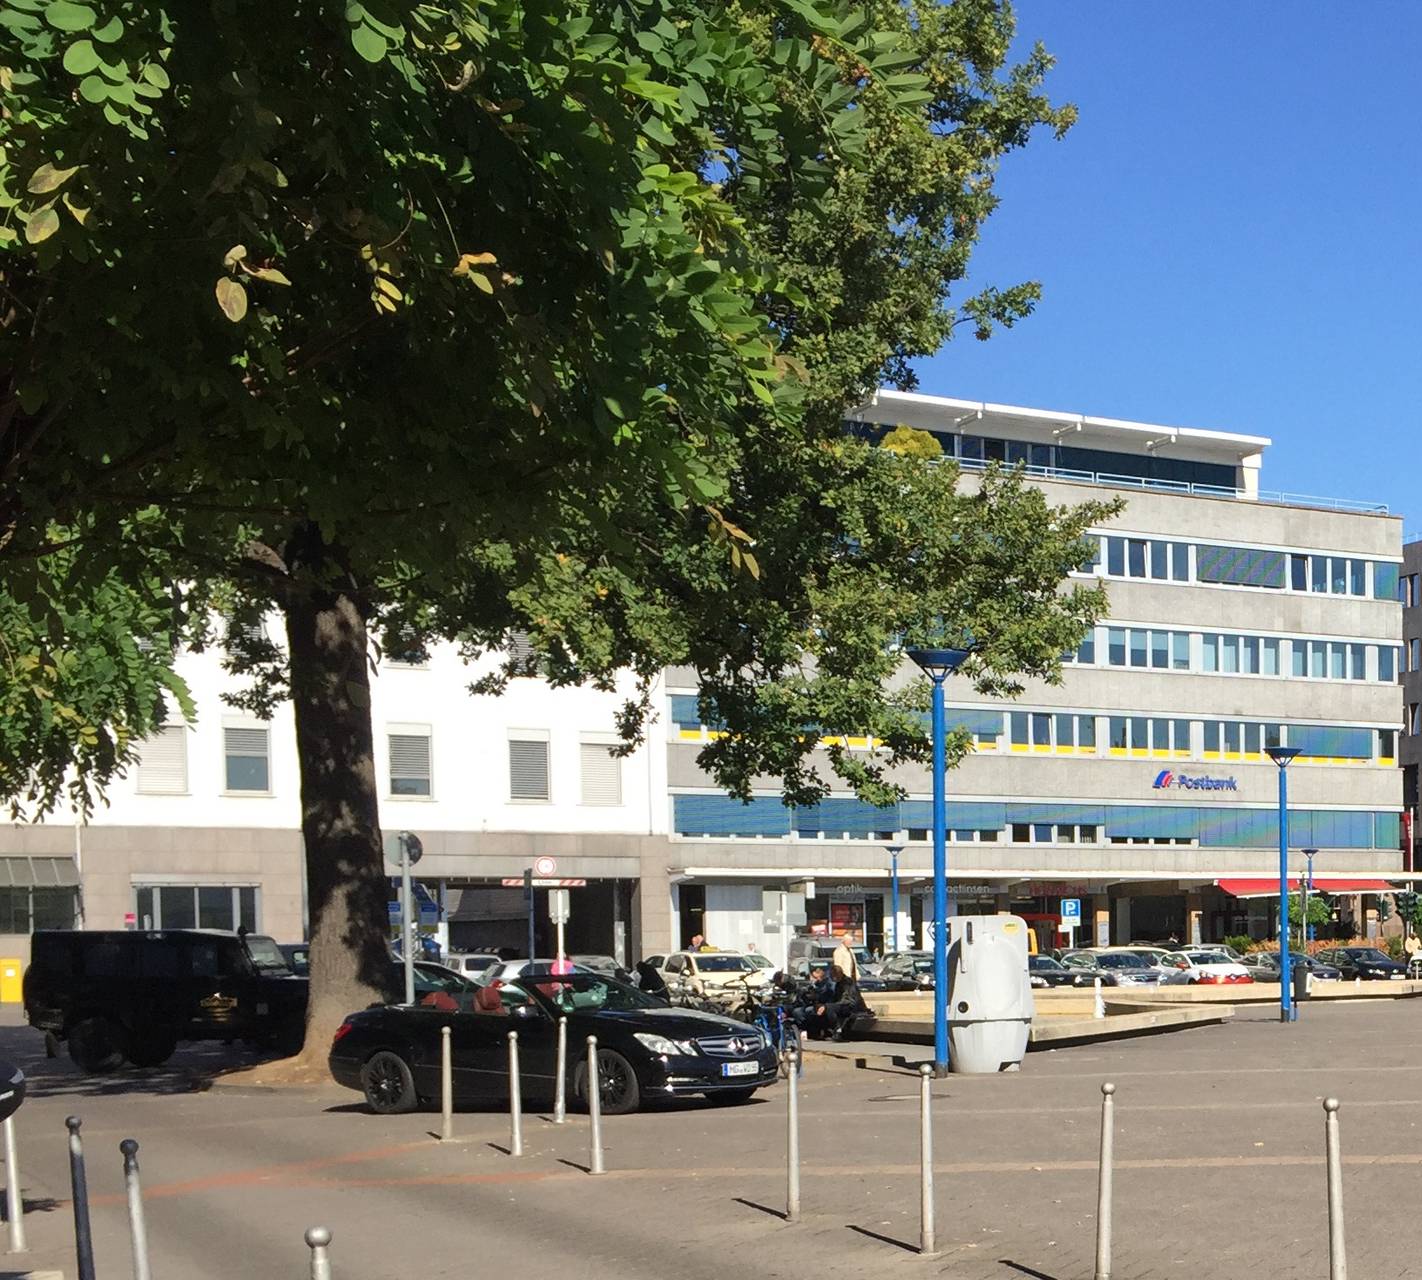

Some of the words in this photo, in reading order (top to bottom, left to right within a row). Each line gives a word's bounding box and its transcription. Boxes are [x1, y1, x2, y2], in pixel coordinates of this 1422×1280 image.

[1178, 775, 1237, 791] Postbank
[836, 884, 863, 895] optik
[924, 884, 990, 894] coactlinsen
